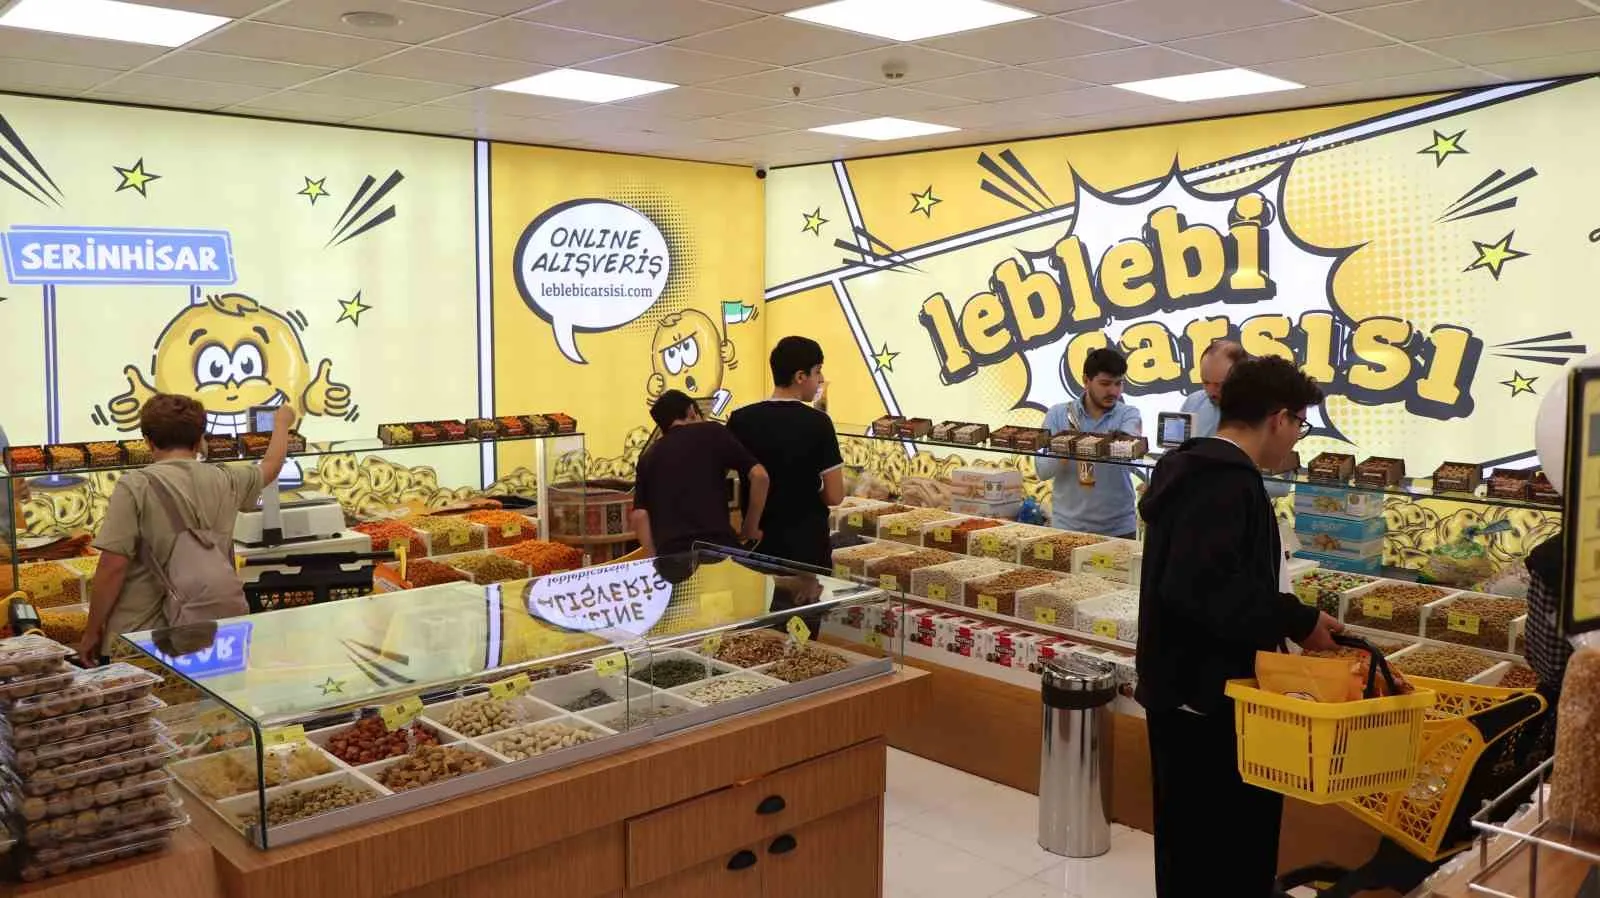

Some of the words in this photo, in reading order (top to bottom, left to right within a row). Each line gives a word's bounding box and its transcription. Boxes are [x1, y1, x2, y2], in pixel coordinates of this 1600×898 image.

[550, 227, 642, 249] ONLINE
[21, 237, 220, 272] SERİNHİSAR
[531, 248, 664, 280] ALIŞVERİŞ
[541, 283, 653, 297] leblebicarsisi.com
[919, 191, 1275, 382] leblebi
